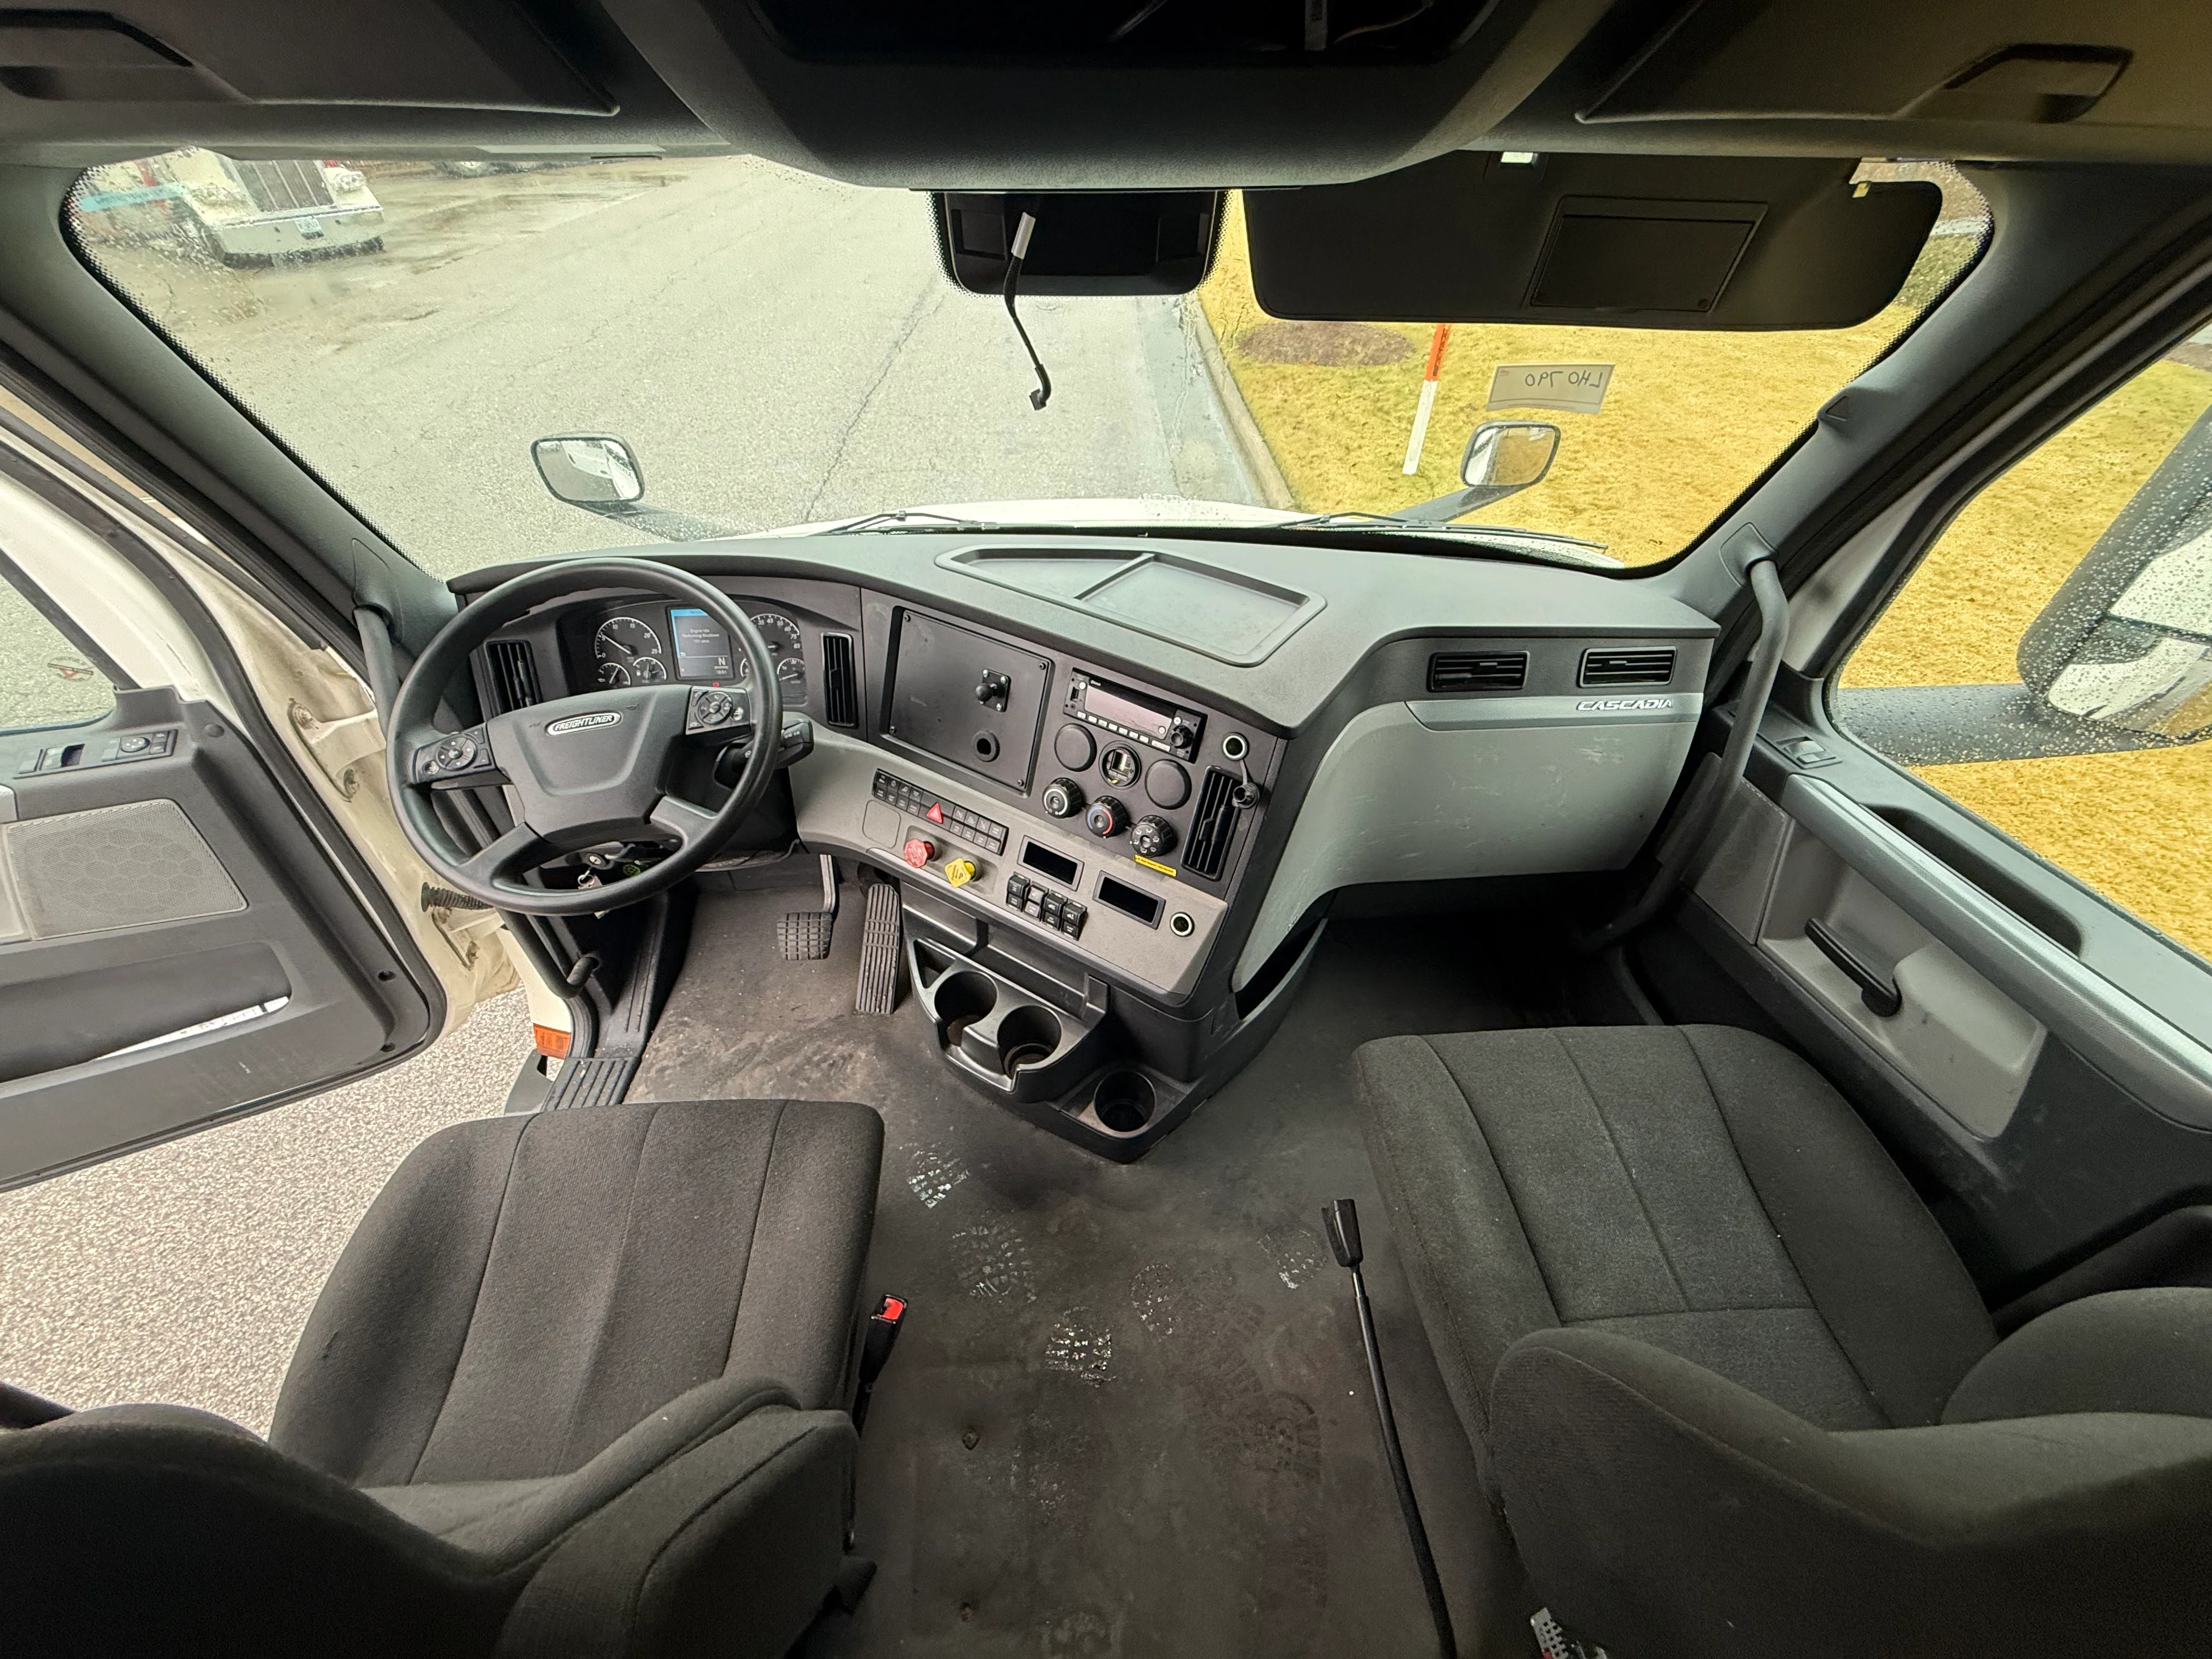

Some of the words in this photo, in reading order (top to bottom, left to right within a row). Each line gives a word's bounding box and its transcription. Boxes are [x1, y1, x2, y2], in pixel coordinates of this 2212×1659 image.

[718, 657, 726, 665] N
[1577, 699, 1673, 710] CASCADIA
[555, 715, 612, 731] FREIGHTLINER
